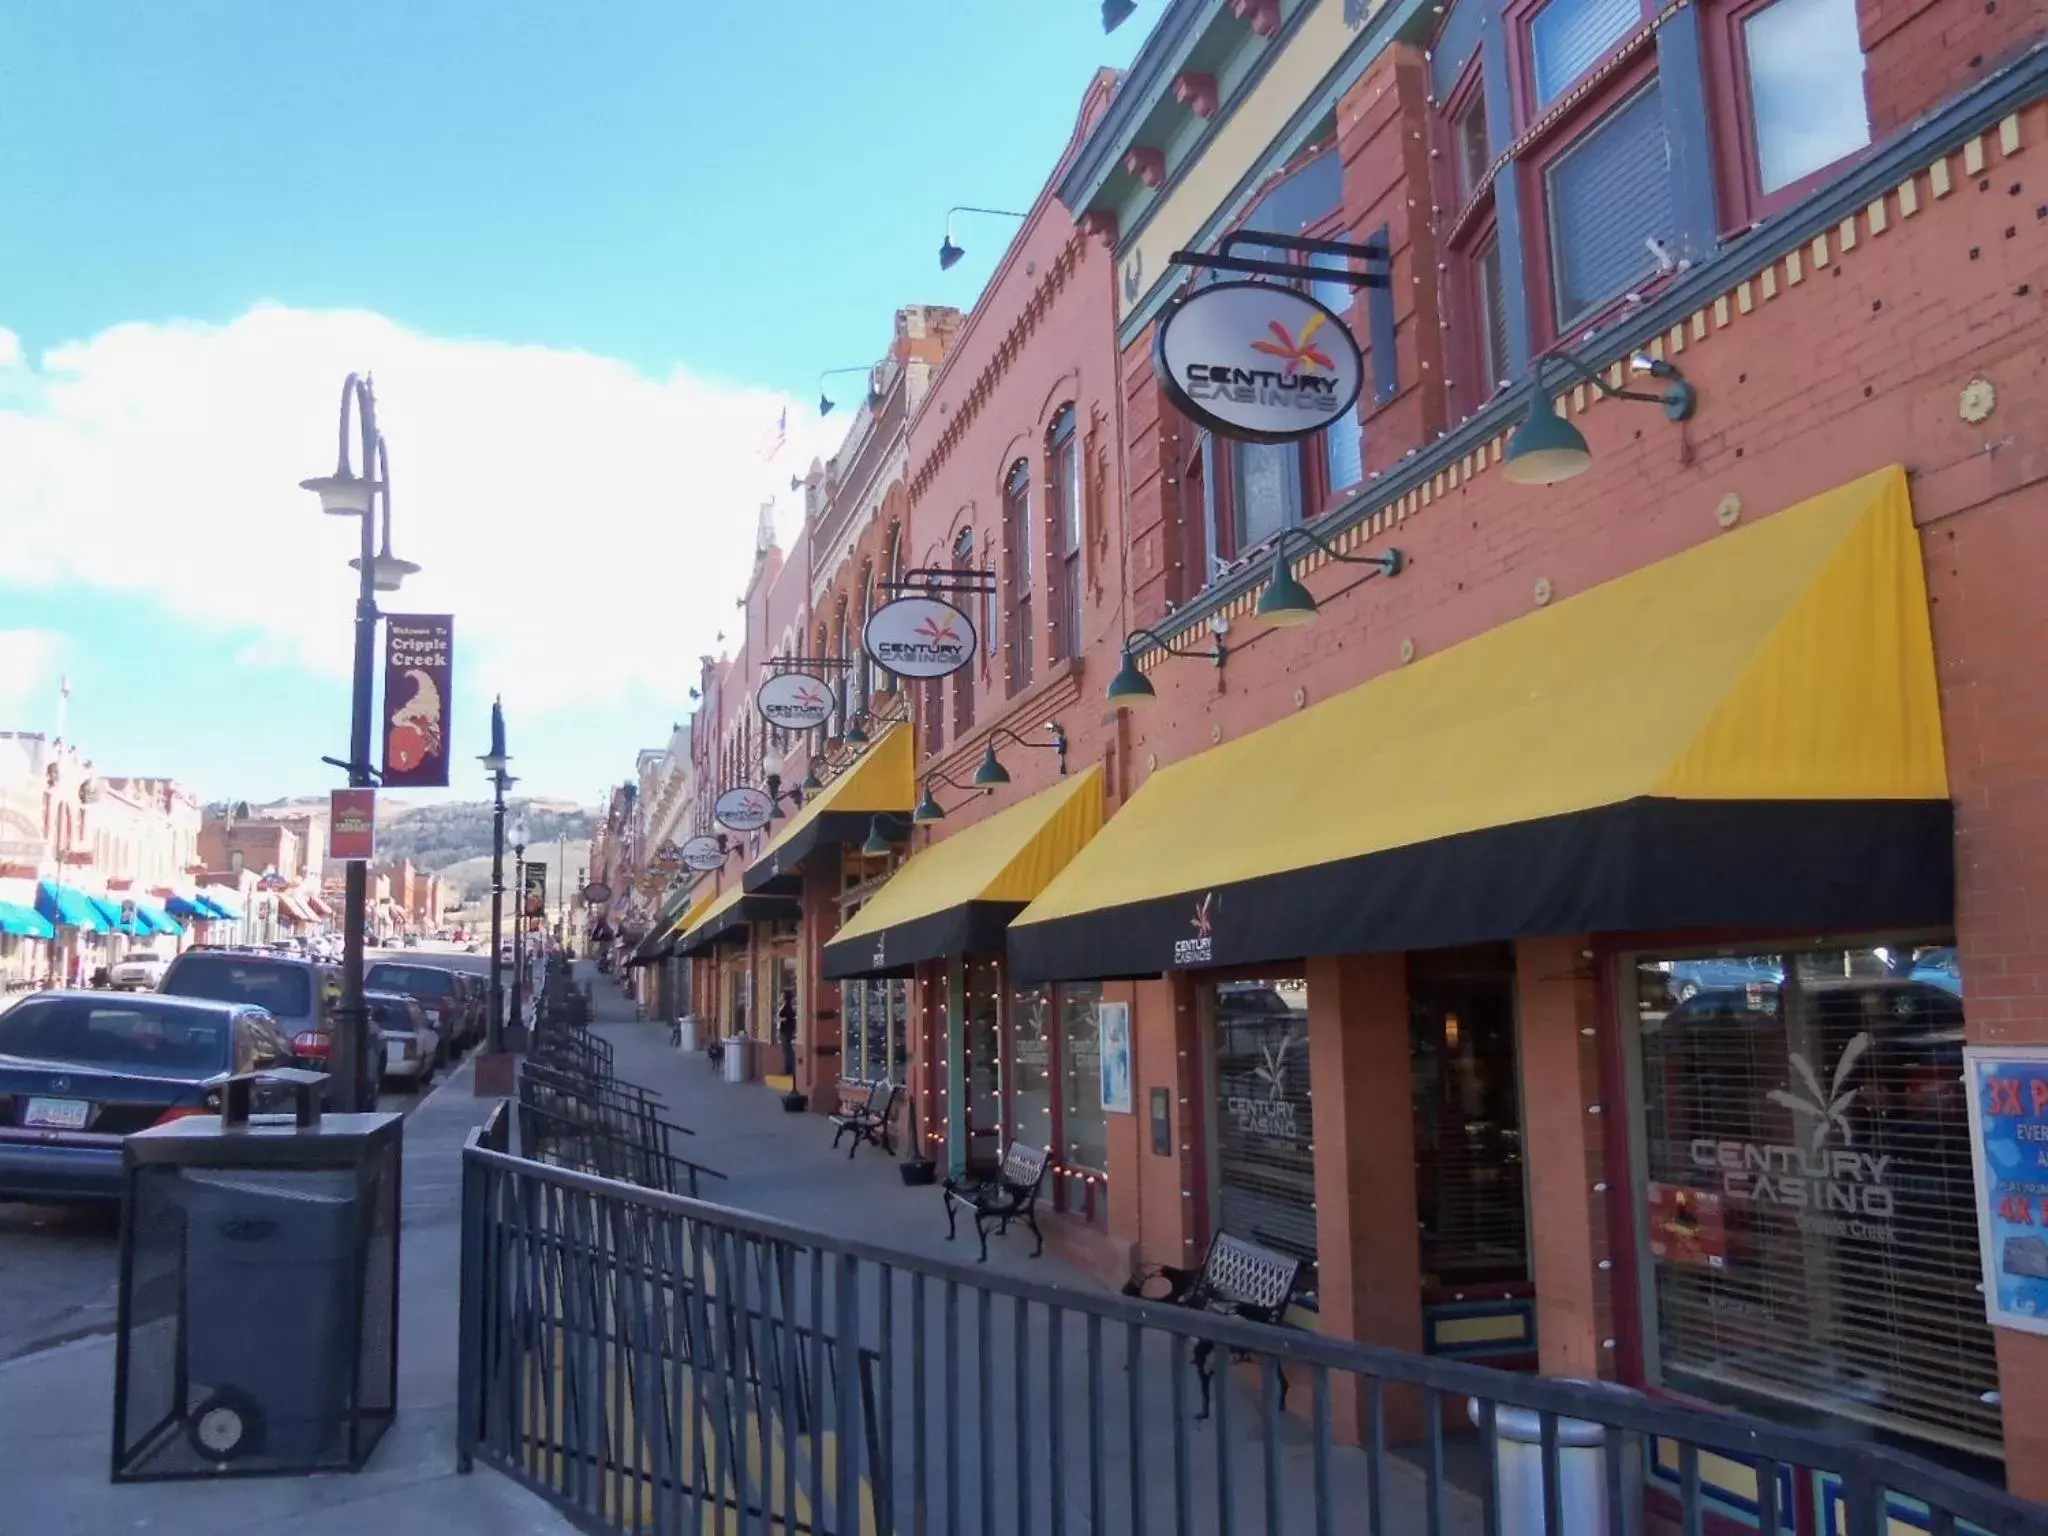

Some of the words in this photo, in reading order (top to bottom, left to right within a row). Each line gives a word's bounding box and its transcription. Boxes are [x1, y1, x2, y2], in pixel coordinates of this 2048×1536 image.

[1186, 363, 1340, 394] CENTURY
[1186, 380, 1339, 412] CASINOS
[391, 638, 448, 652] Cripple
[878, 643, 963, 655] CENTURY
[391, 652, 449, 666] Creek
[766, 704, 825, 712] CENTURY
[1174, 936, 1213, 953] CENTURY
[1174, 949, 1212, 965] CASINOS
[1986, 1074, 2024, 1116] 3X
[1227, 1097, 1296, 1119] CENTURY
[1238, 1116, 1297, 1138] CASINO
[1690, 1138, 1892, 1184] CENTURY
[1723, 1171, 1894, 1218] CASINO
